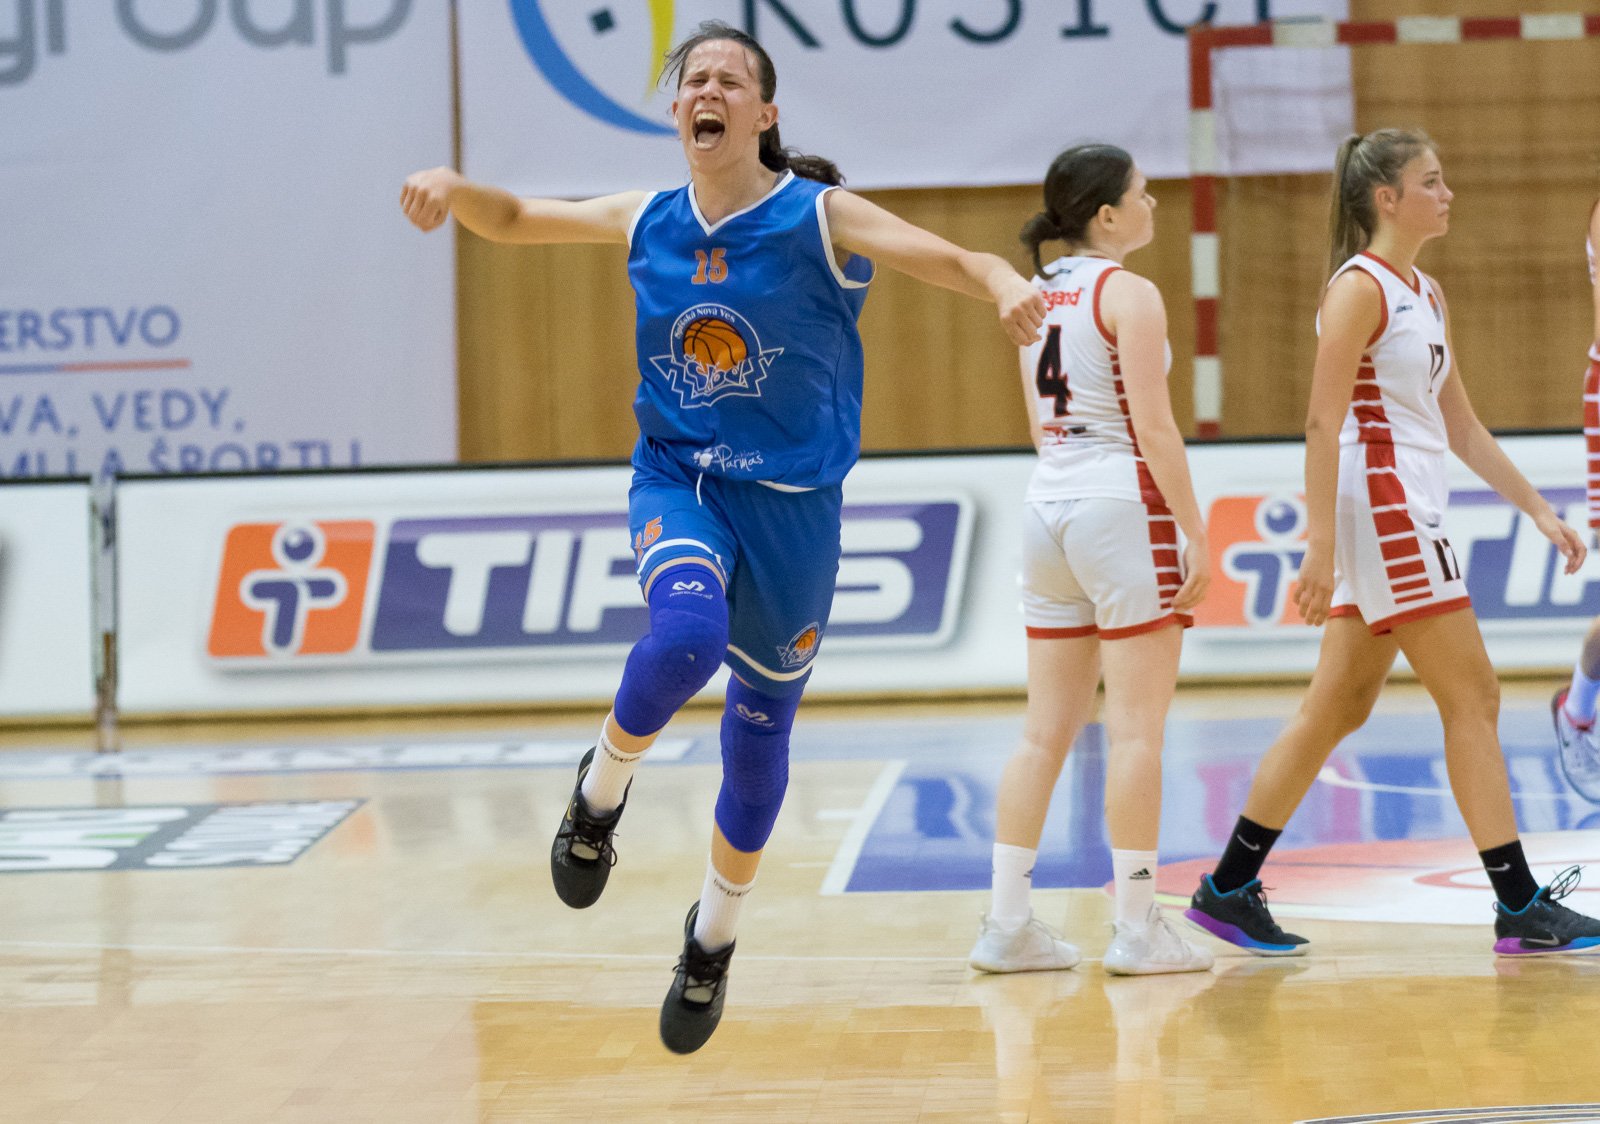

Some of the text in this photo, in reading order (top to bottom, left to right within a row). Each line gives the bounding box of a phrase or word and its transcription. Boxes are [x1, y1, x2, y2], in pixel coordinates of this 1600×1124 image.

[691, 247, 729, 285] 15
[719, 308, 736, 323] Ves
[1036, 324, 1073, 417] 4
[92, 387, 246, 433] VEDY,
[415, 518, 925, 636] TIPS
